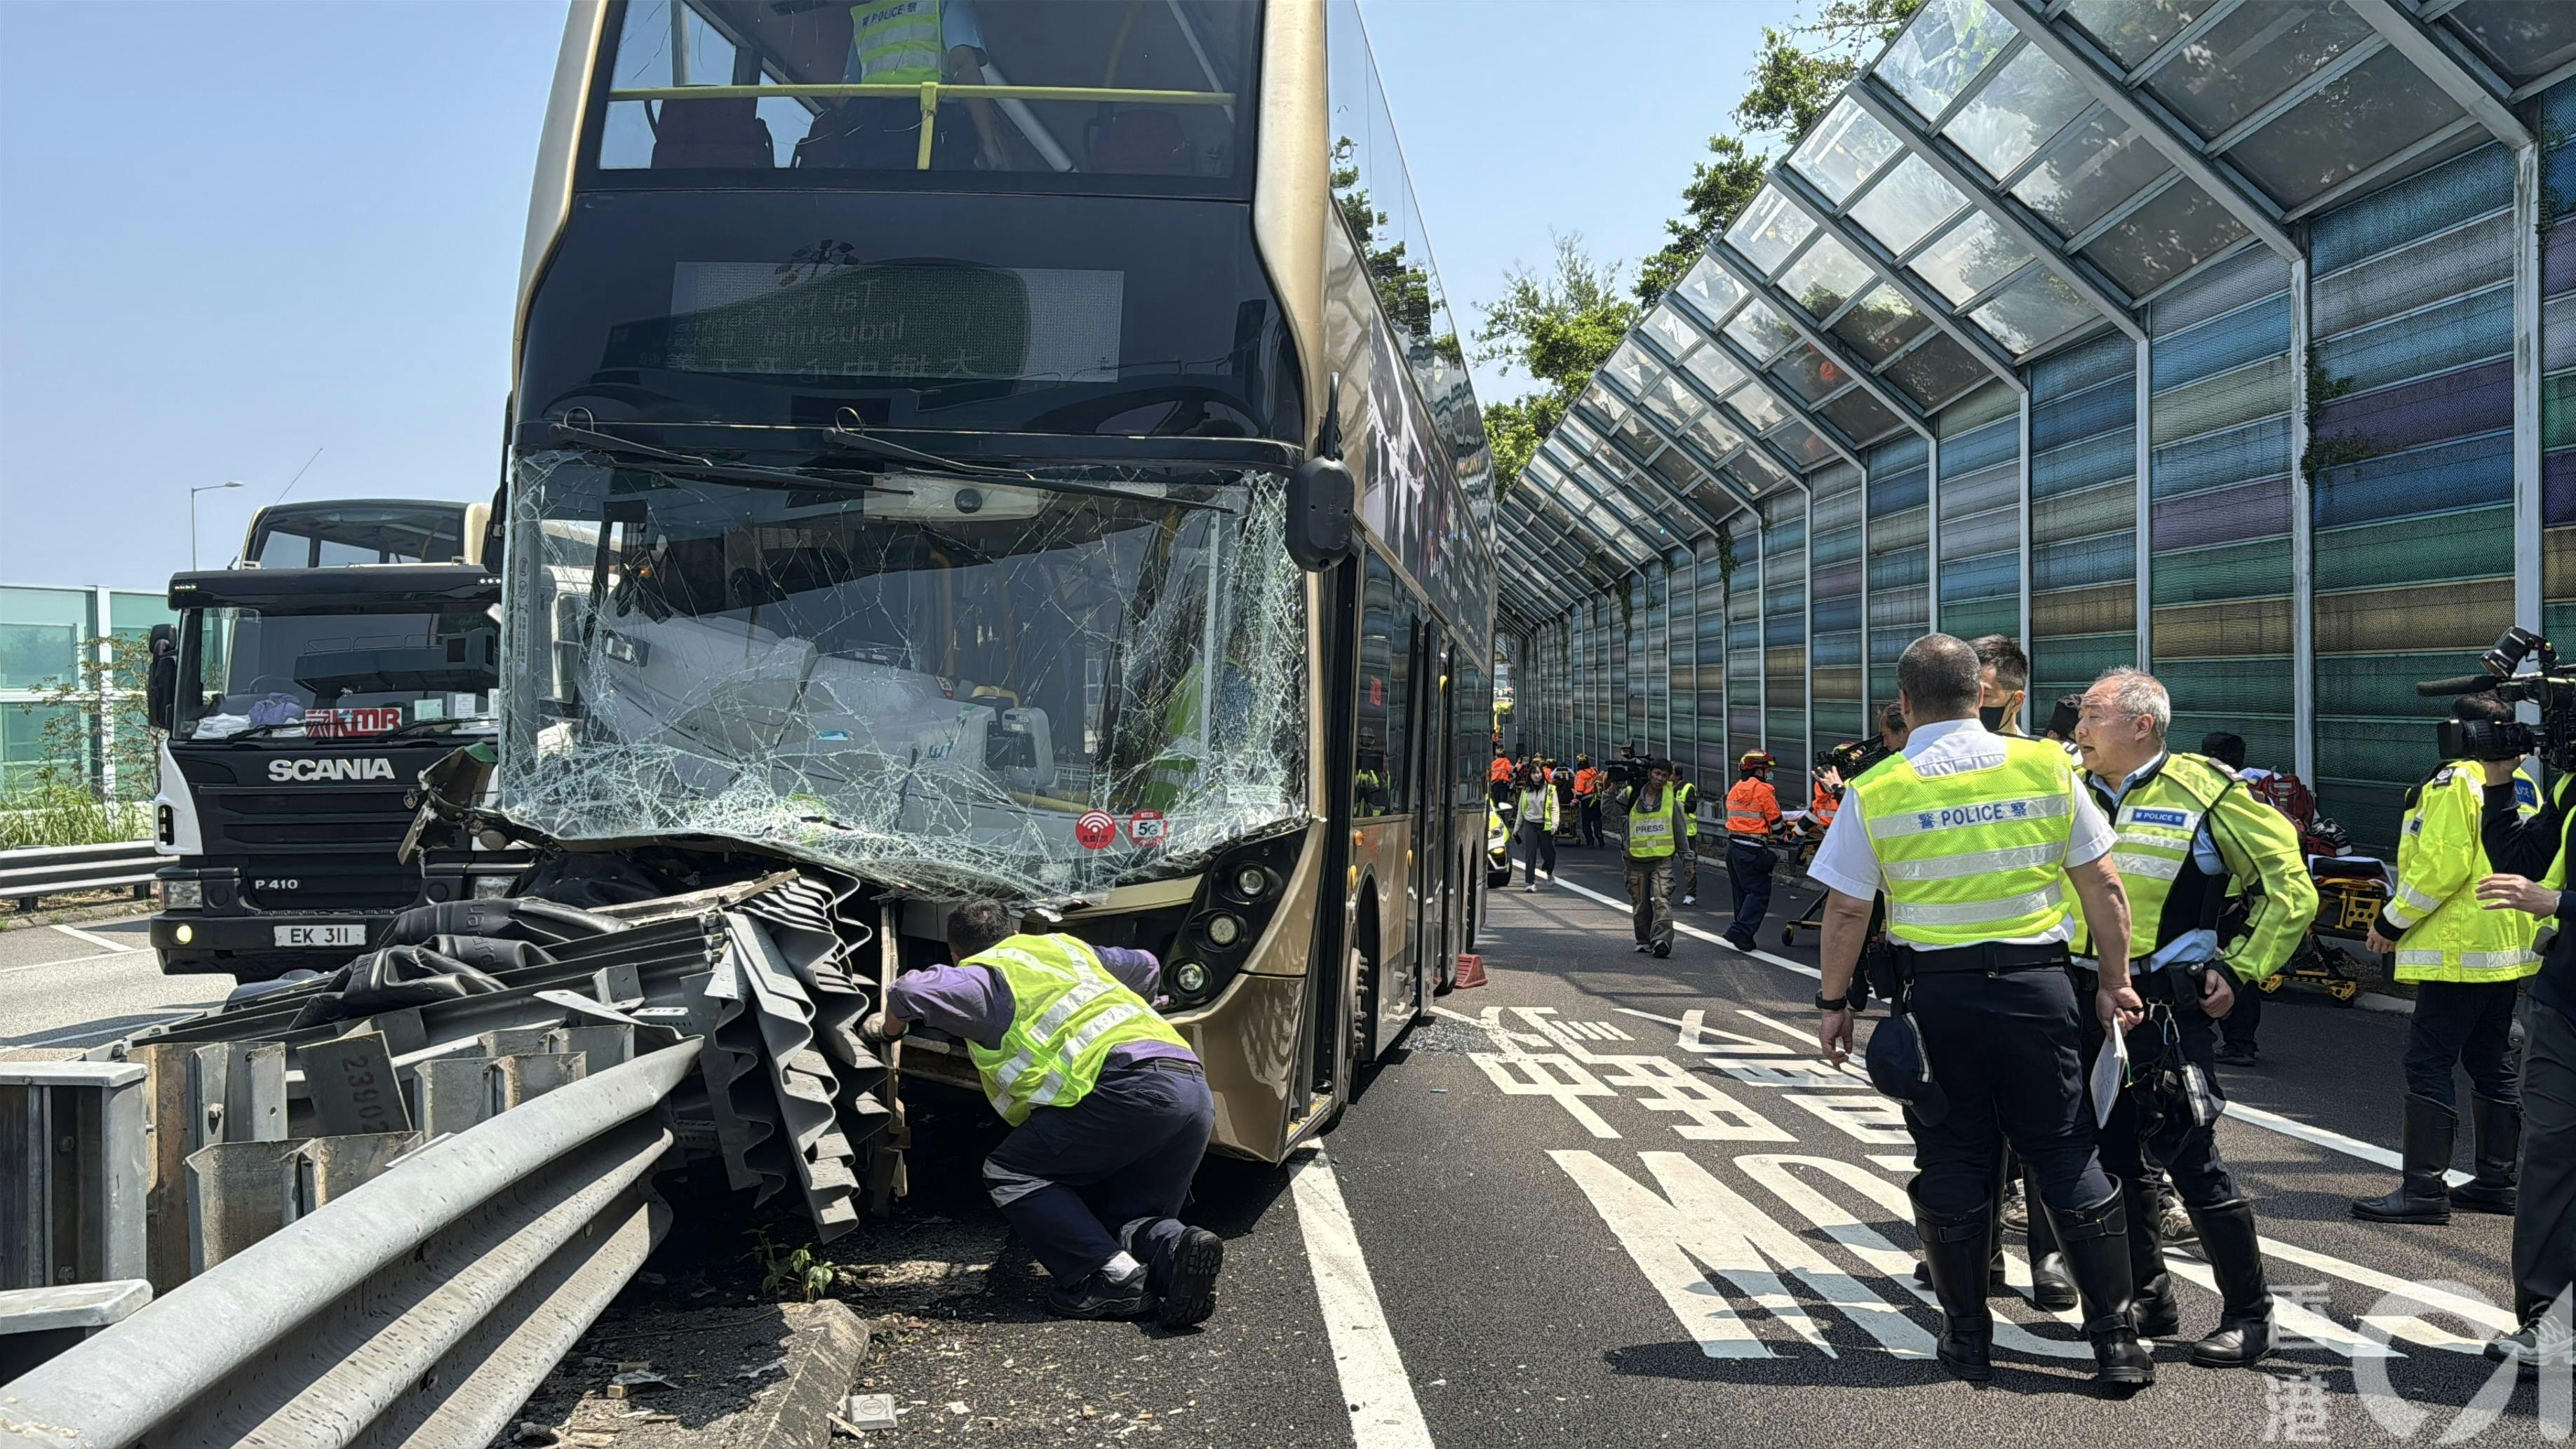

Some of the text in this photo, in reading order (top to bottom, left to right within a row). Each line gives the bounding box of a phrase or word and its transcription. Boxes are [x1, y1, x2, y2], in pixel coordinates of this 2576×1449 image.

[871, 4, 904, 23] POLICE
[268, 757, 396, 781] SCANIA
[1918, 802, 2027, 830] 警 POLICE 察
[2143, 812, 2173, 821] POLICE
[1138, 821, 1159, 836] 5G
[1635, 823, 1665, 834] PRESS
[255, 879, 299, 890] P 410
[290, 928, 349, 944] EK 311
